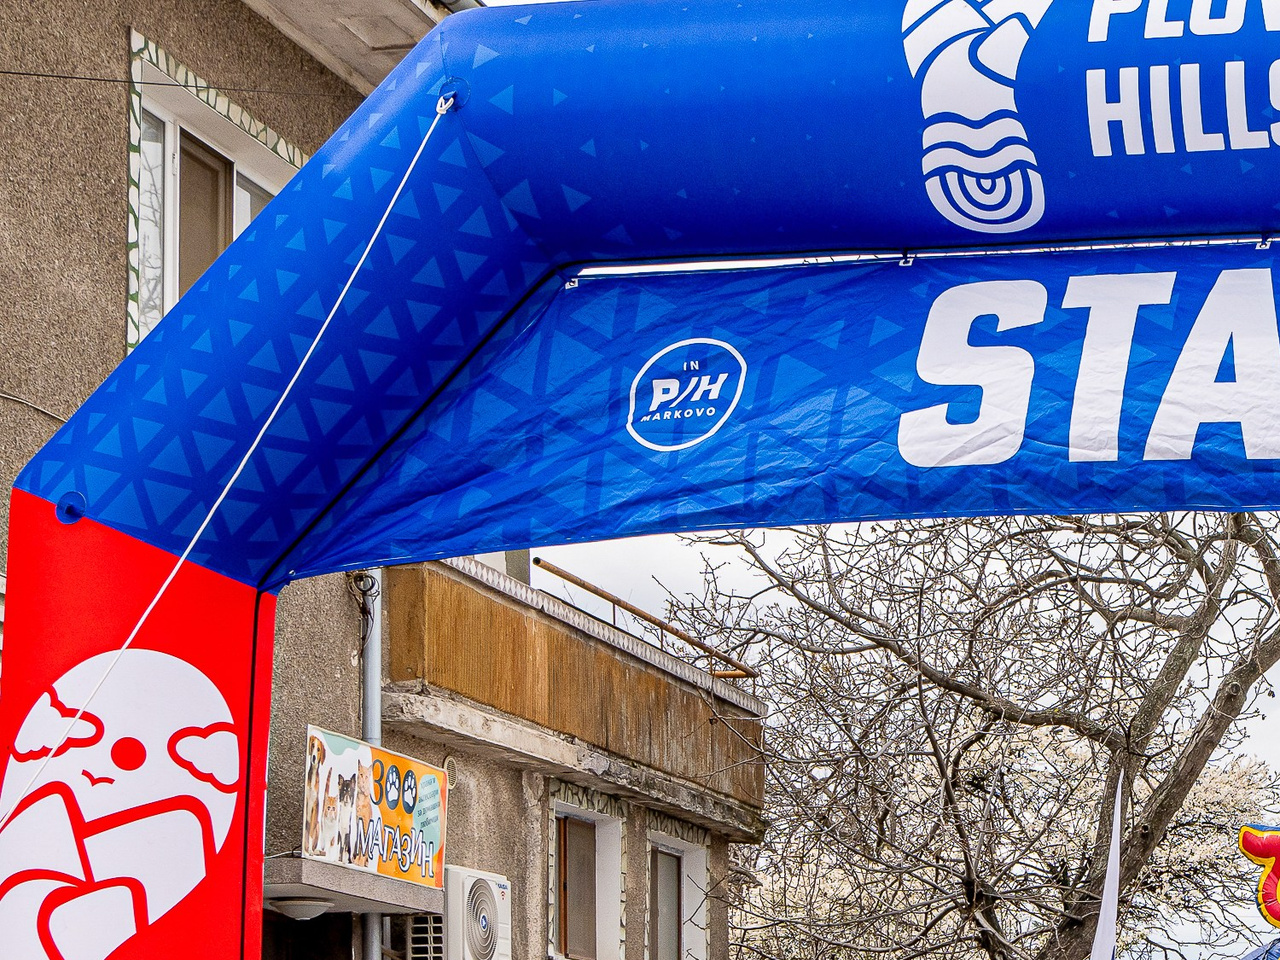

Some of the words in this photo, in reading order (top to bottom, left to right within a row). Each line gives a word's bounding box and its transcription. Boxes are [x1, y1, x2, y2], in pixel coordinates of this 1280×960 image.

[683, 360, 699, 371] IN
[649, 373, 729, 412] P/H
[640, 407, 716, 422] MARKOVO
[356, 817, 434, 877] МАГАЗИН
